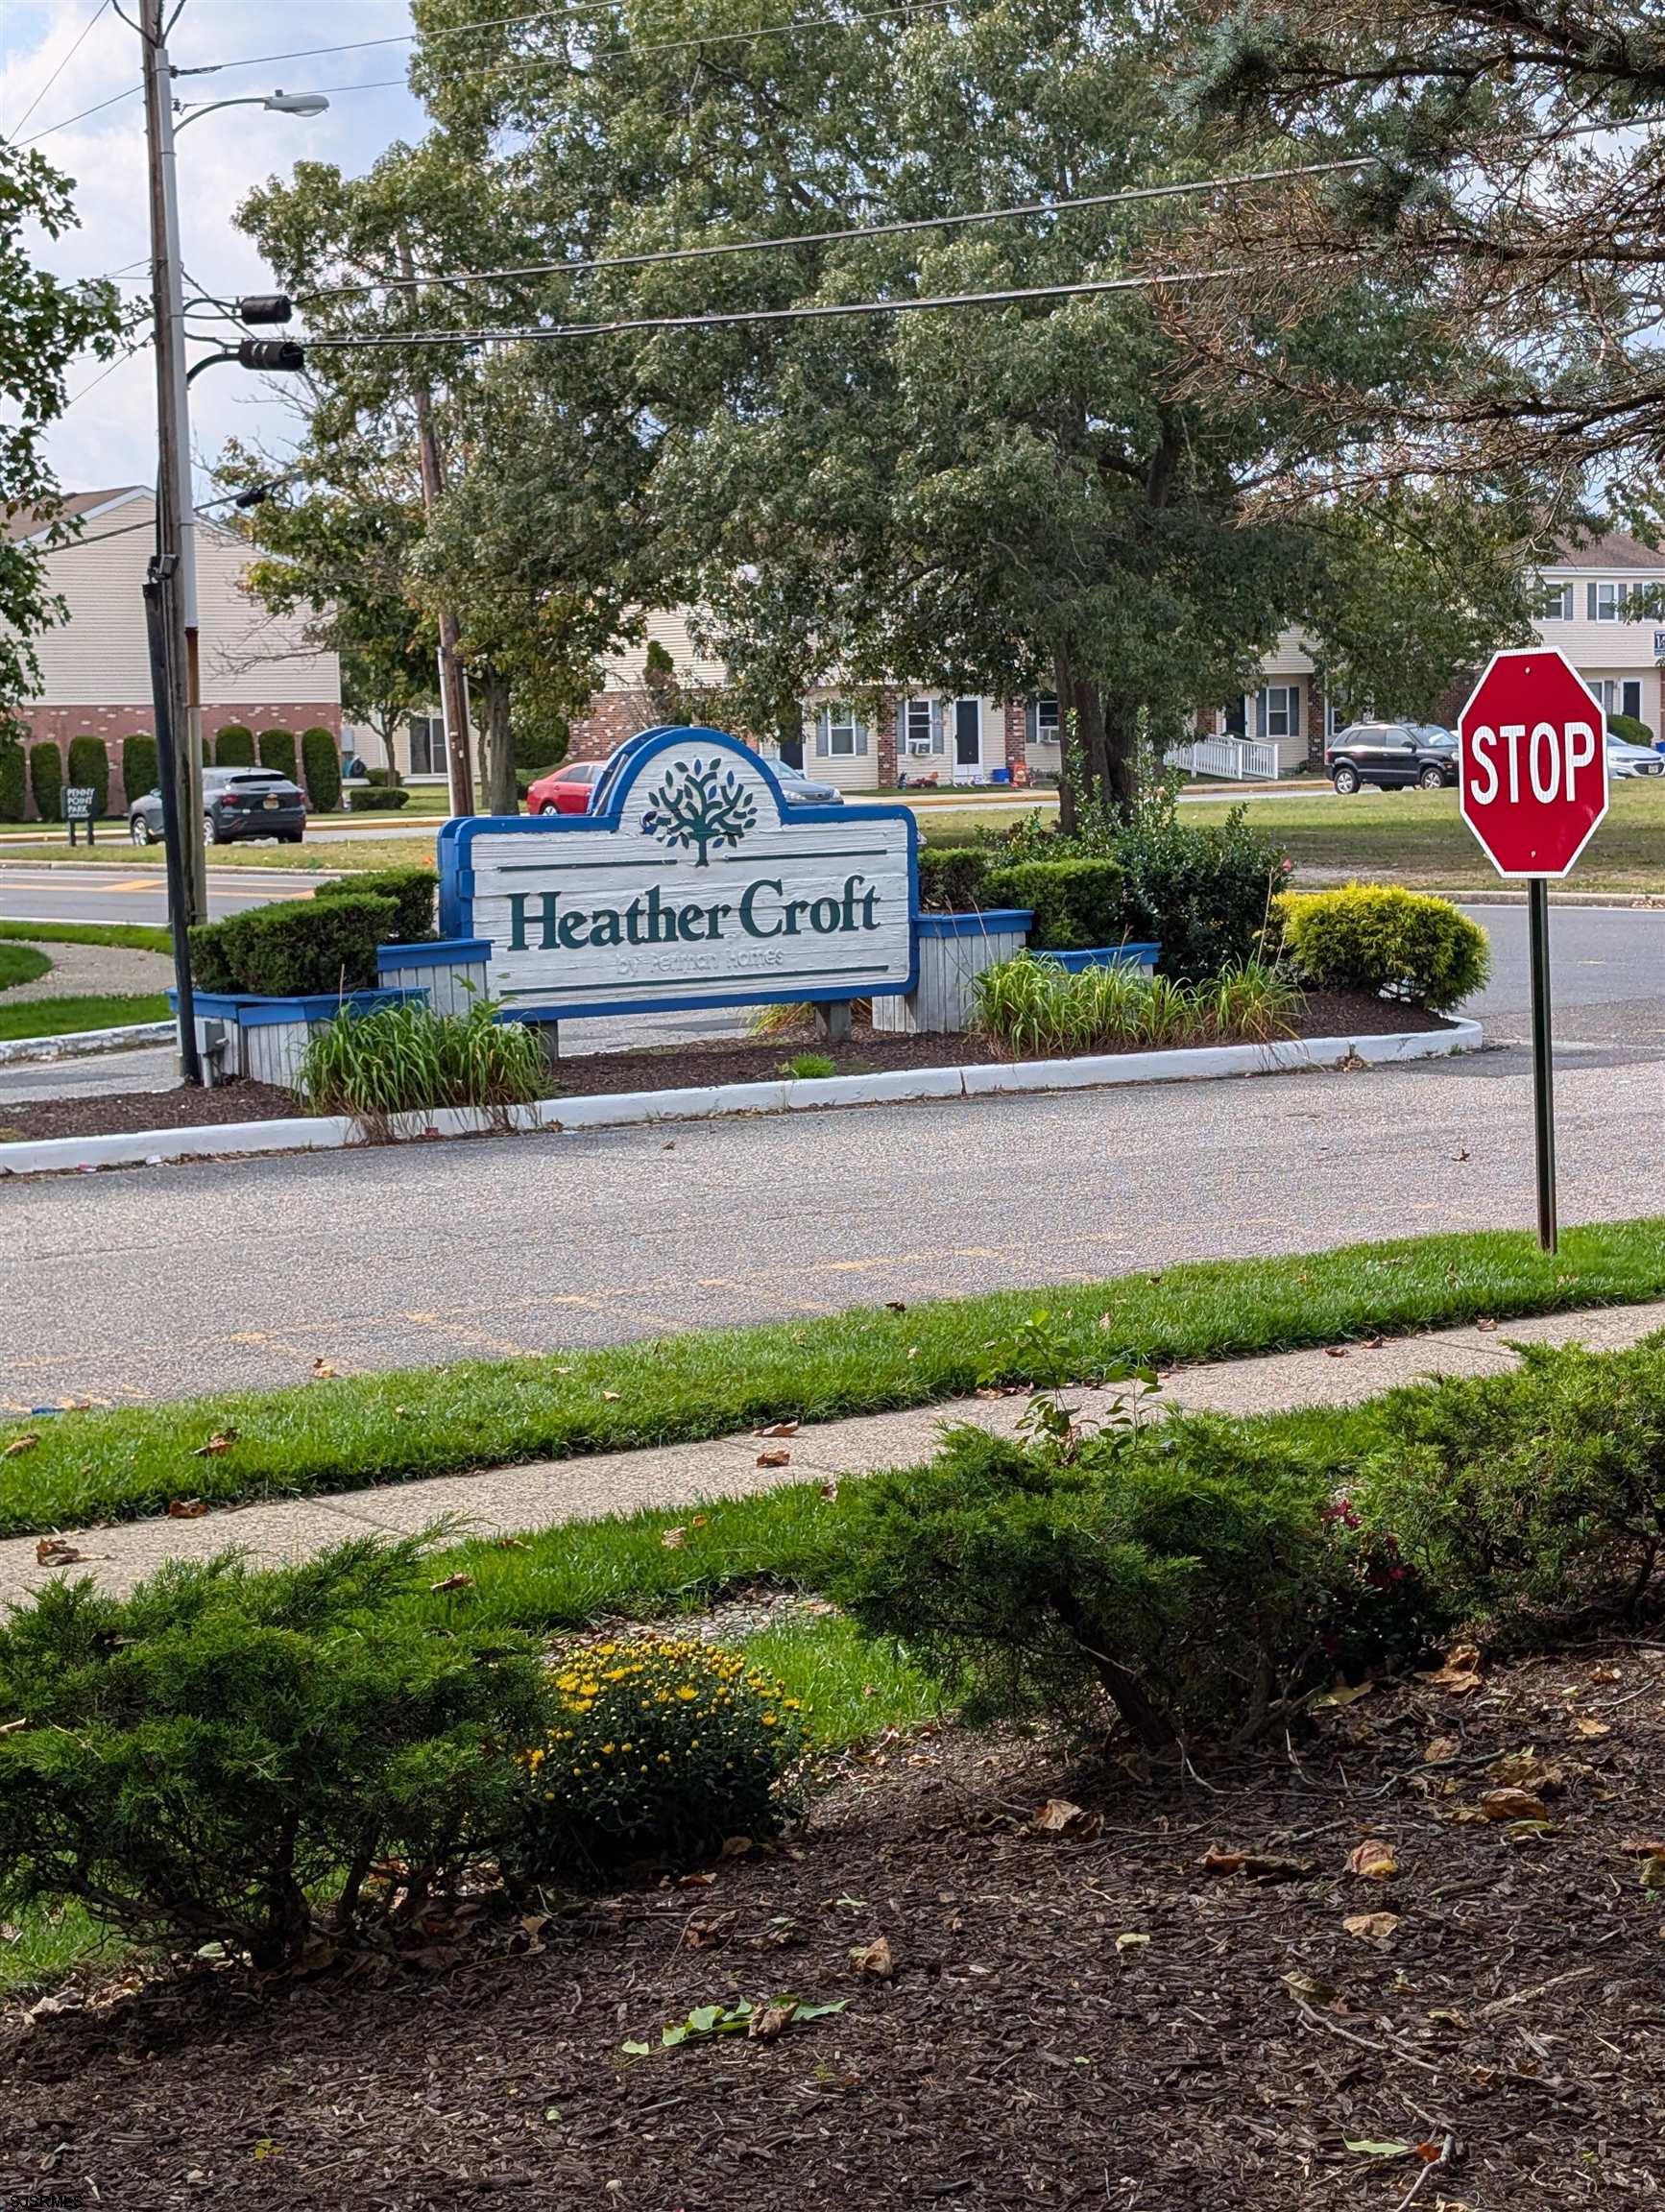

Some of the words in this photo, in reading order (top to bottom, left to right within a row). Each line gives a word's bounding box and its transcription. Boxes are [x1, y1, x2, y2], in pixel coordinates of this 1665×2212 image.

[1471, 722, 1595, 805] STOP
[67, 787, 94, 797] PENNY
[67, 797, 92, 805] POINT
[67, 805, 88, 815] PARK
[617, 952, 639, 977] by
